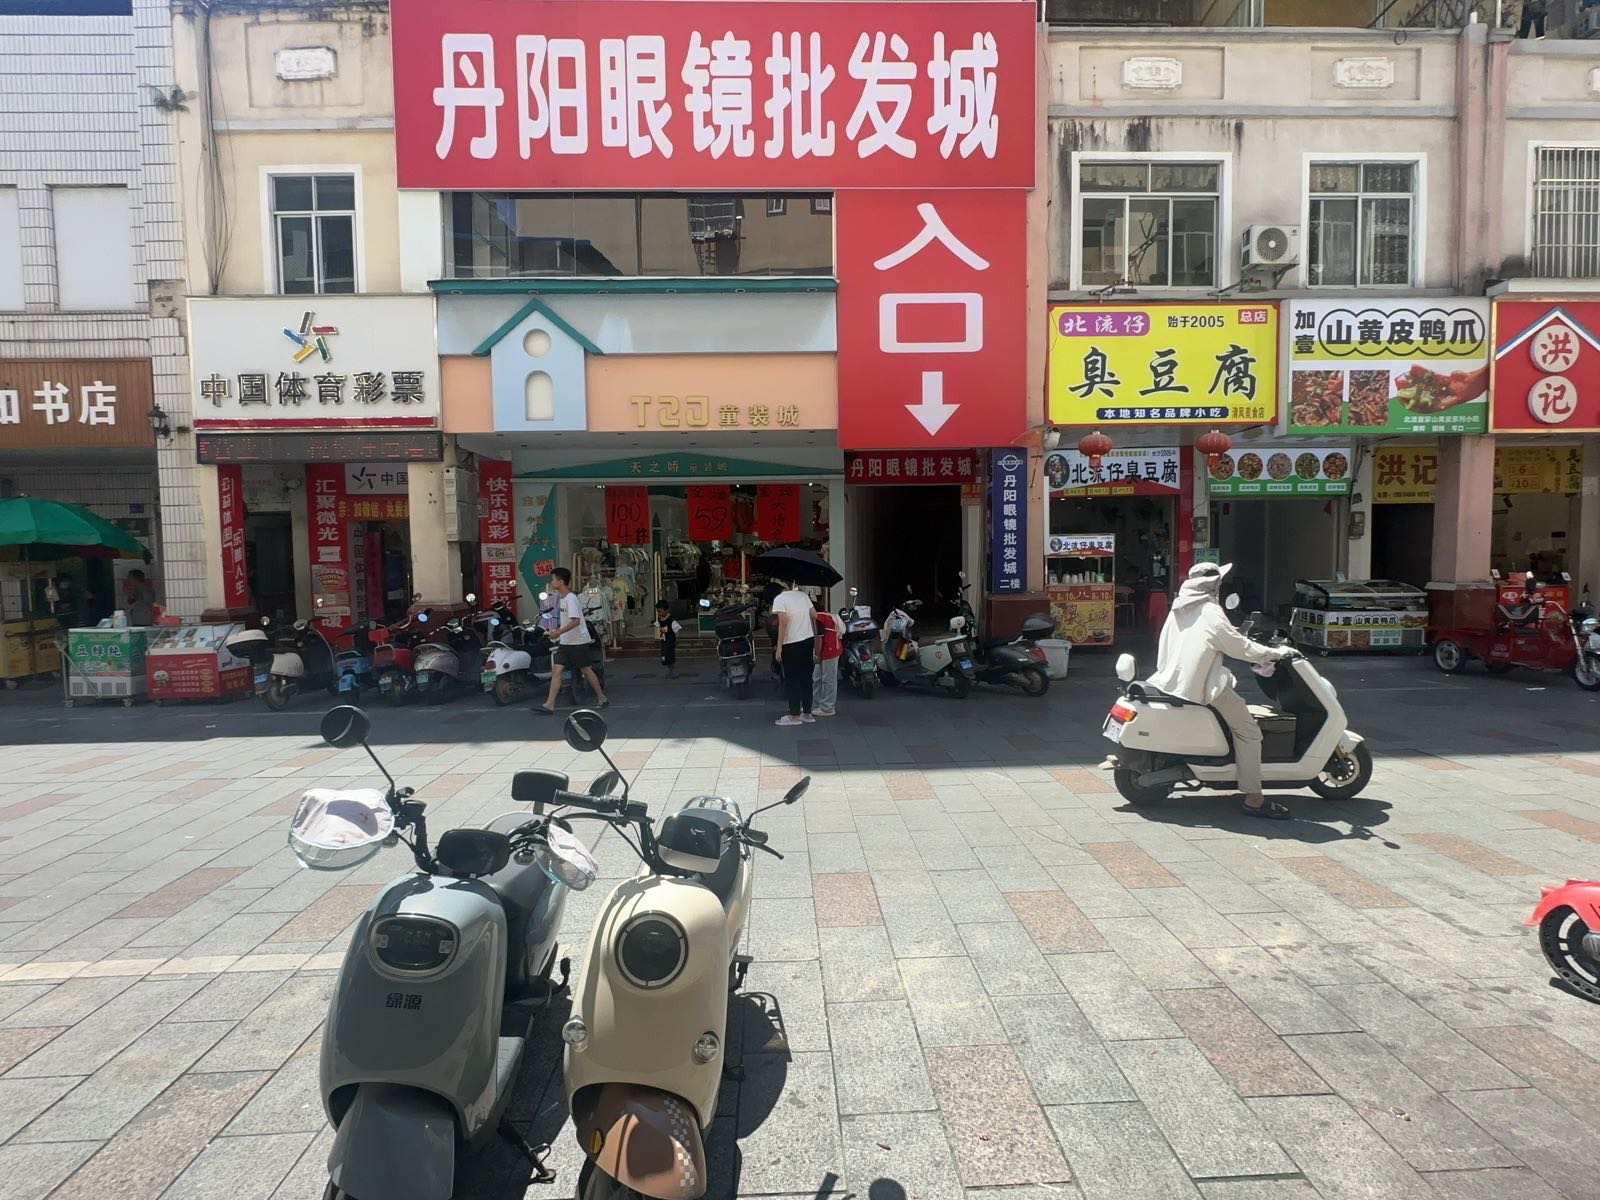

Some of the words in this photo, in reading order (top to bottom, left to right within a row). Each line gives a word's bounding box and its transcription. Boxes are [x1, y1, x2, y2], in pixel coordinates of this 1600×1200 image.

[432, 31, 1000, 160] 丹阳眼镜批发城
[873, 203, 990, 354] 入口
[1064, 315, 1146, 333] 北流仔
[1168, 315, 1225, 328] 始于2005
[1240, 310, 1267, 322] 总店
[1294, 310, 1316, 354] 加壹
[1326, 318, 1478, 345] 山黄皮鸭爪
[1068, 344, 1257, 401] 臭豆腐
[1538, 331, 1575, 415] 洪记
[200, 371, 424, 407] 中国体育彩票
[719, 404, 800, 426] 童装城
[1104, 407, 1222, 419] 本地知名品牌小吃
[851, 457, 972, 478] 丹阳眼镜批发城
[1377, 454, 1438, 486] 洪记
[315, 479, 339, 541] 汇聚微光
[487, 477, 510, 539] 快乐购彩
[1003, 474, 1017, 574] 丹阳眼镜批发城
[999, 578, 1021, 589] 二楼
[385, 992, 423, 1010] 绿源
